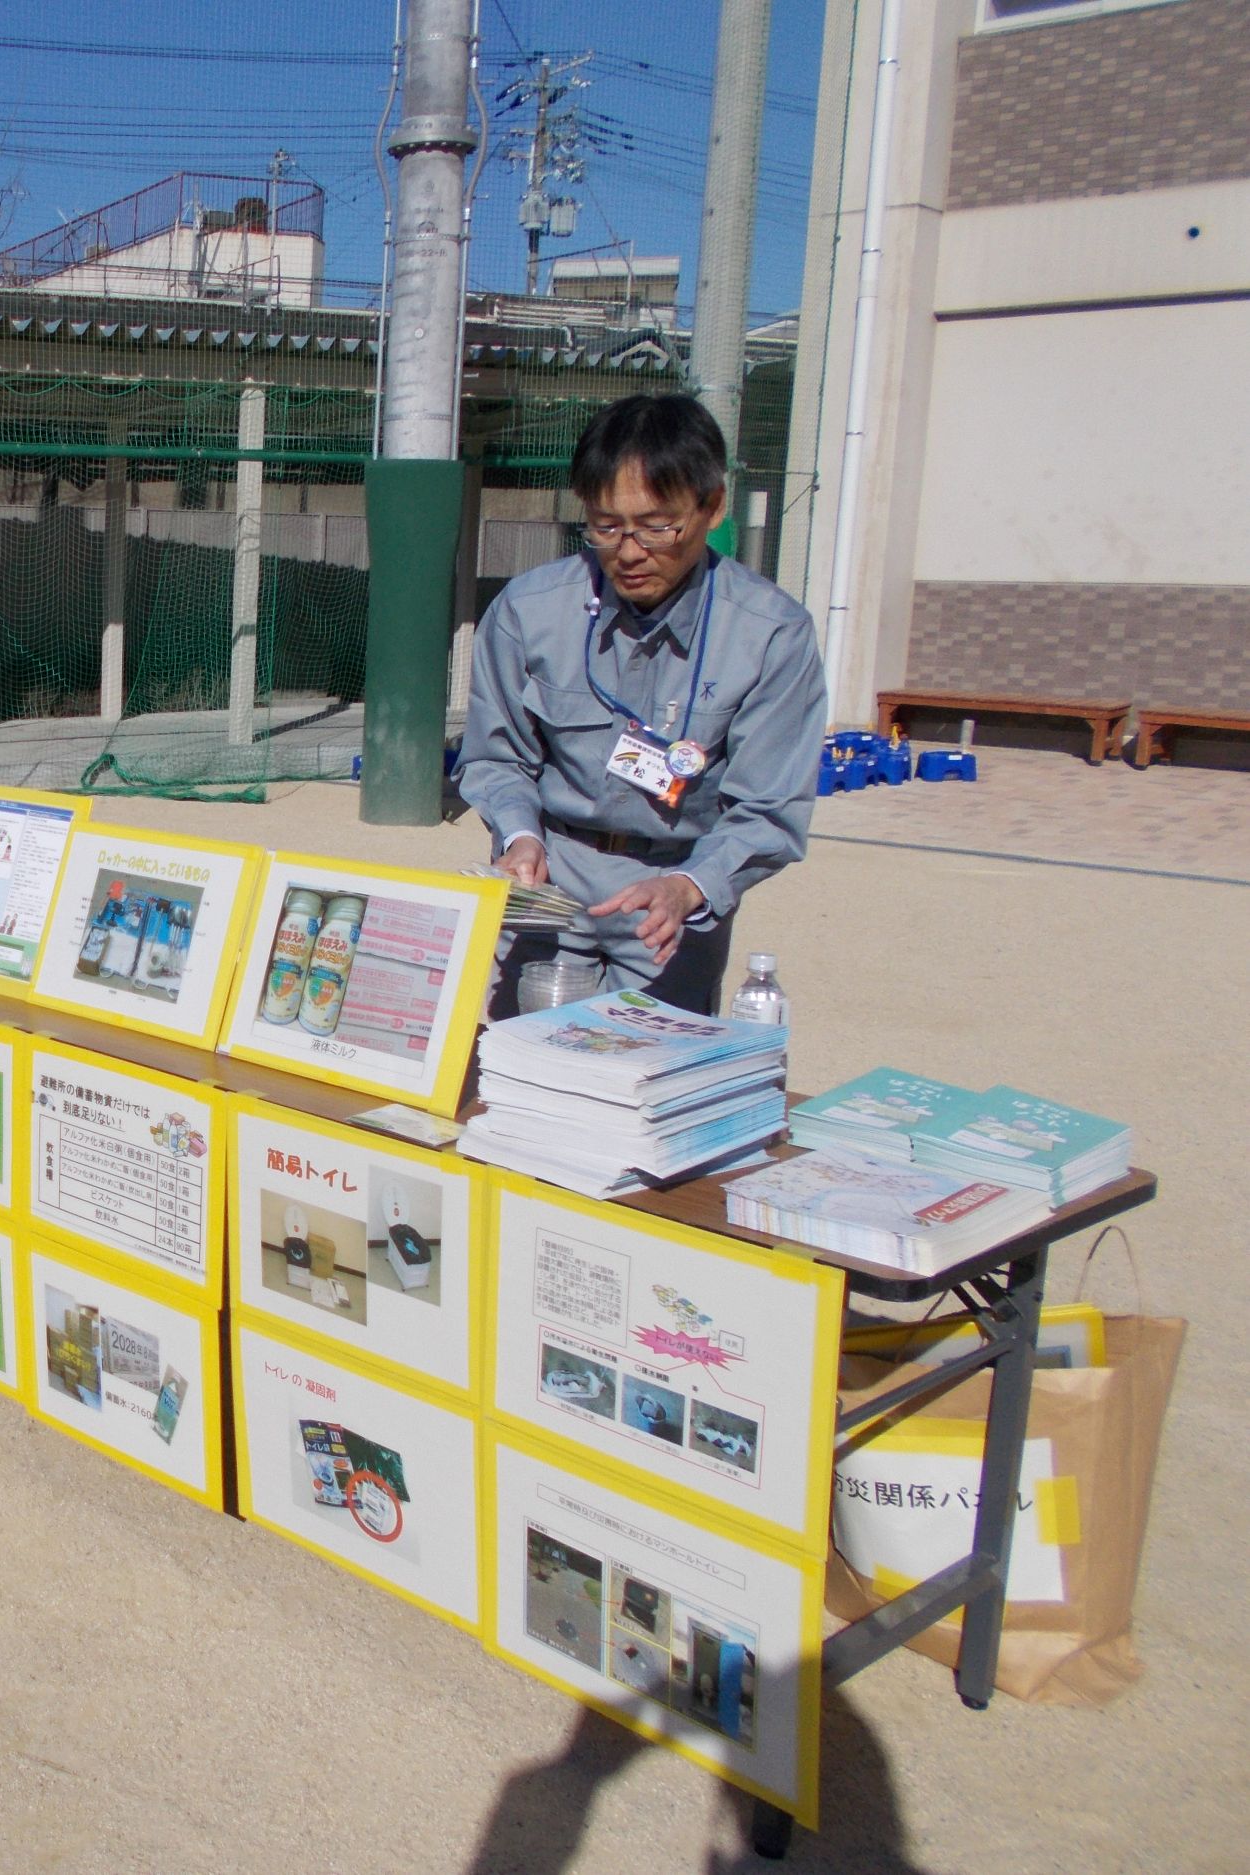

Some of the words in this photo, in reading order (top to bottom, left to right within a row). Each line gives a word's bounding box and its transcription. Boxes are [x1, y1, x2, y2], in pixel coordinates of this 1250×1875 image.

[97, 851, 211, 883] ロッカーの中に入っているもの
[310, 1038, 357, 1060] 液体ミルク
[40, 1074, 150, 1120] 避難所の備蓄物資だけでは
[63, 1101, 124, 1128] 到底足りない！
[160, 1160, 176, 1174] 50食
[267, 1148, 358, 1193] 簡易トイレ
[160, 1179, 175, 1193] 50食
[90, 1189, 125, 1210] ビスケット
[158, 1216, 174, 1230] 50食
[95, 1209, 119, 1227] 飲料水
[159, 1198, 175, 1212] 50食
[654, 1334, 718, 1363] トイレが使えない
[833, 1469, 1033, 1512] 災関係パル
